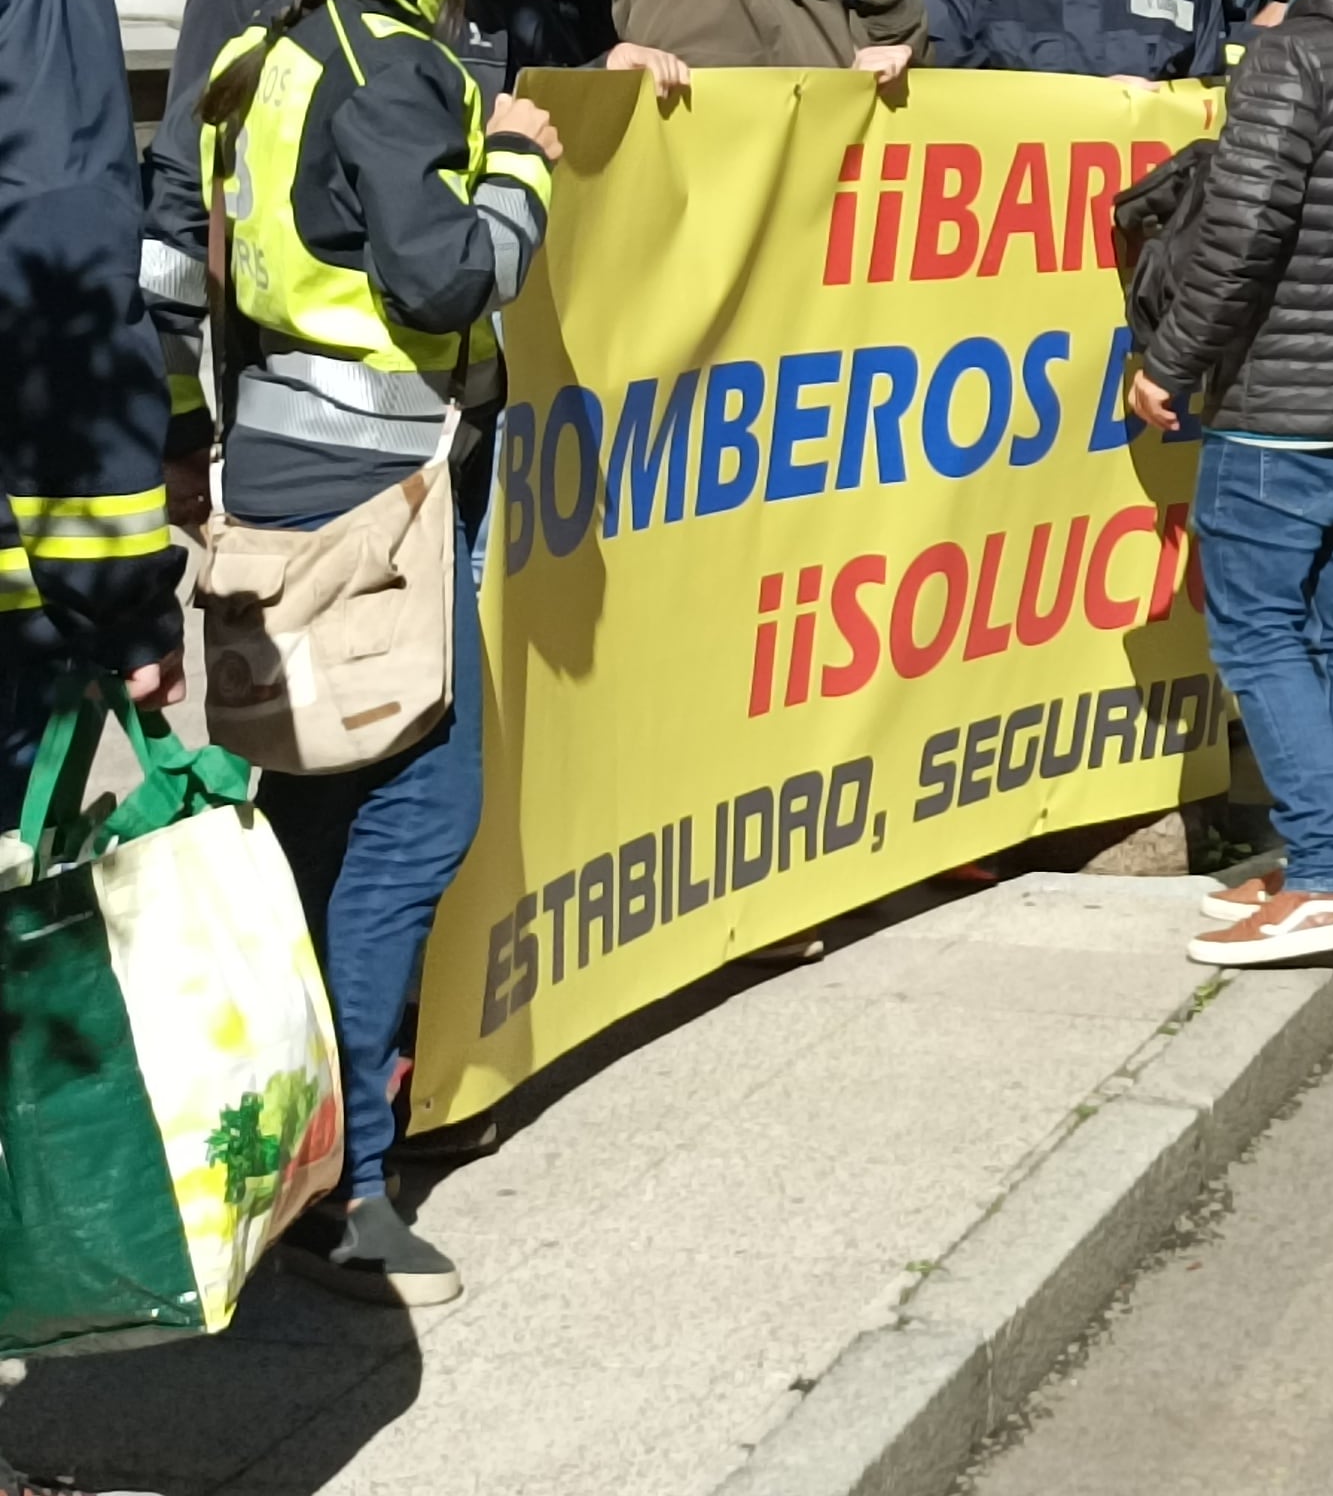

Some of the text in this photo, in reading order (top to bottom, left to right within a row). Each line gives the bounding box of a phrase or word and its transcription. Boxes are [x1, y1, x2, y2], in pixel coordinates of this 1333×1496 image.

[502, 329, 1071, 577] BOMBEROS
[746, 502, 1206, 718] ¡¡SOLUCI
[479, 754, 889, 1038] ESTABILIDAD,
